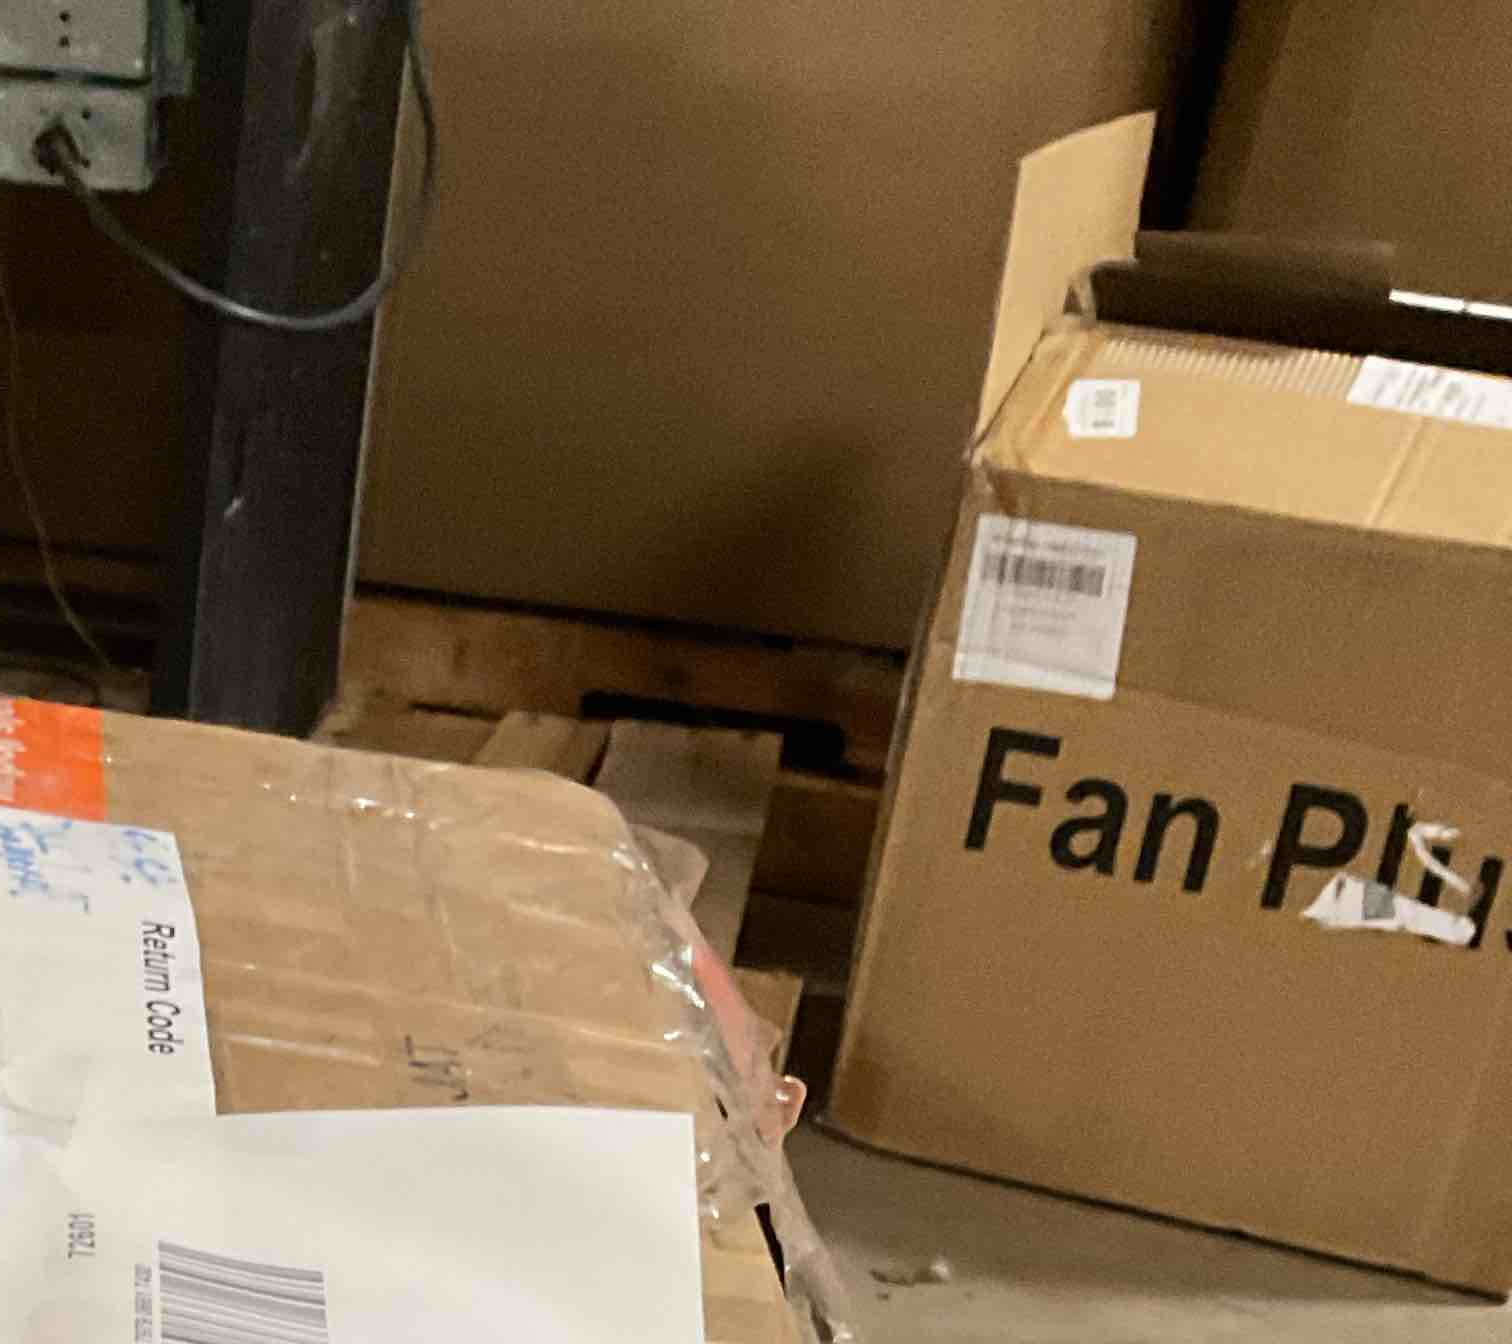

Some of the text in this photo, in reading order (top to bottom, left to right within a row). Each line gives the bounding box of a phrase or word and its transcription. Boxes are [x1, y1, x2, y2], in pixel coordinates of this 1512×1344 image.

[964, 726, 1512, 950] Fan Plu
[142, 919, 176, 993] Return
[146, 999, 183, 1057] Code
[67, 1212, 96, 1260] 72601
